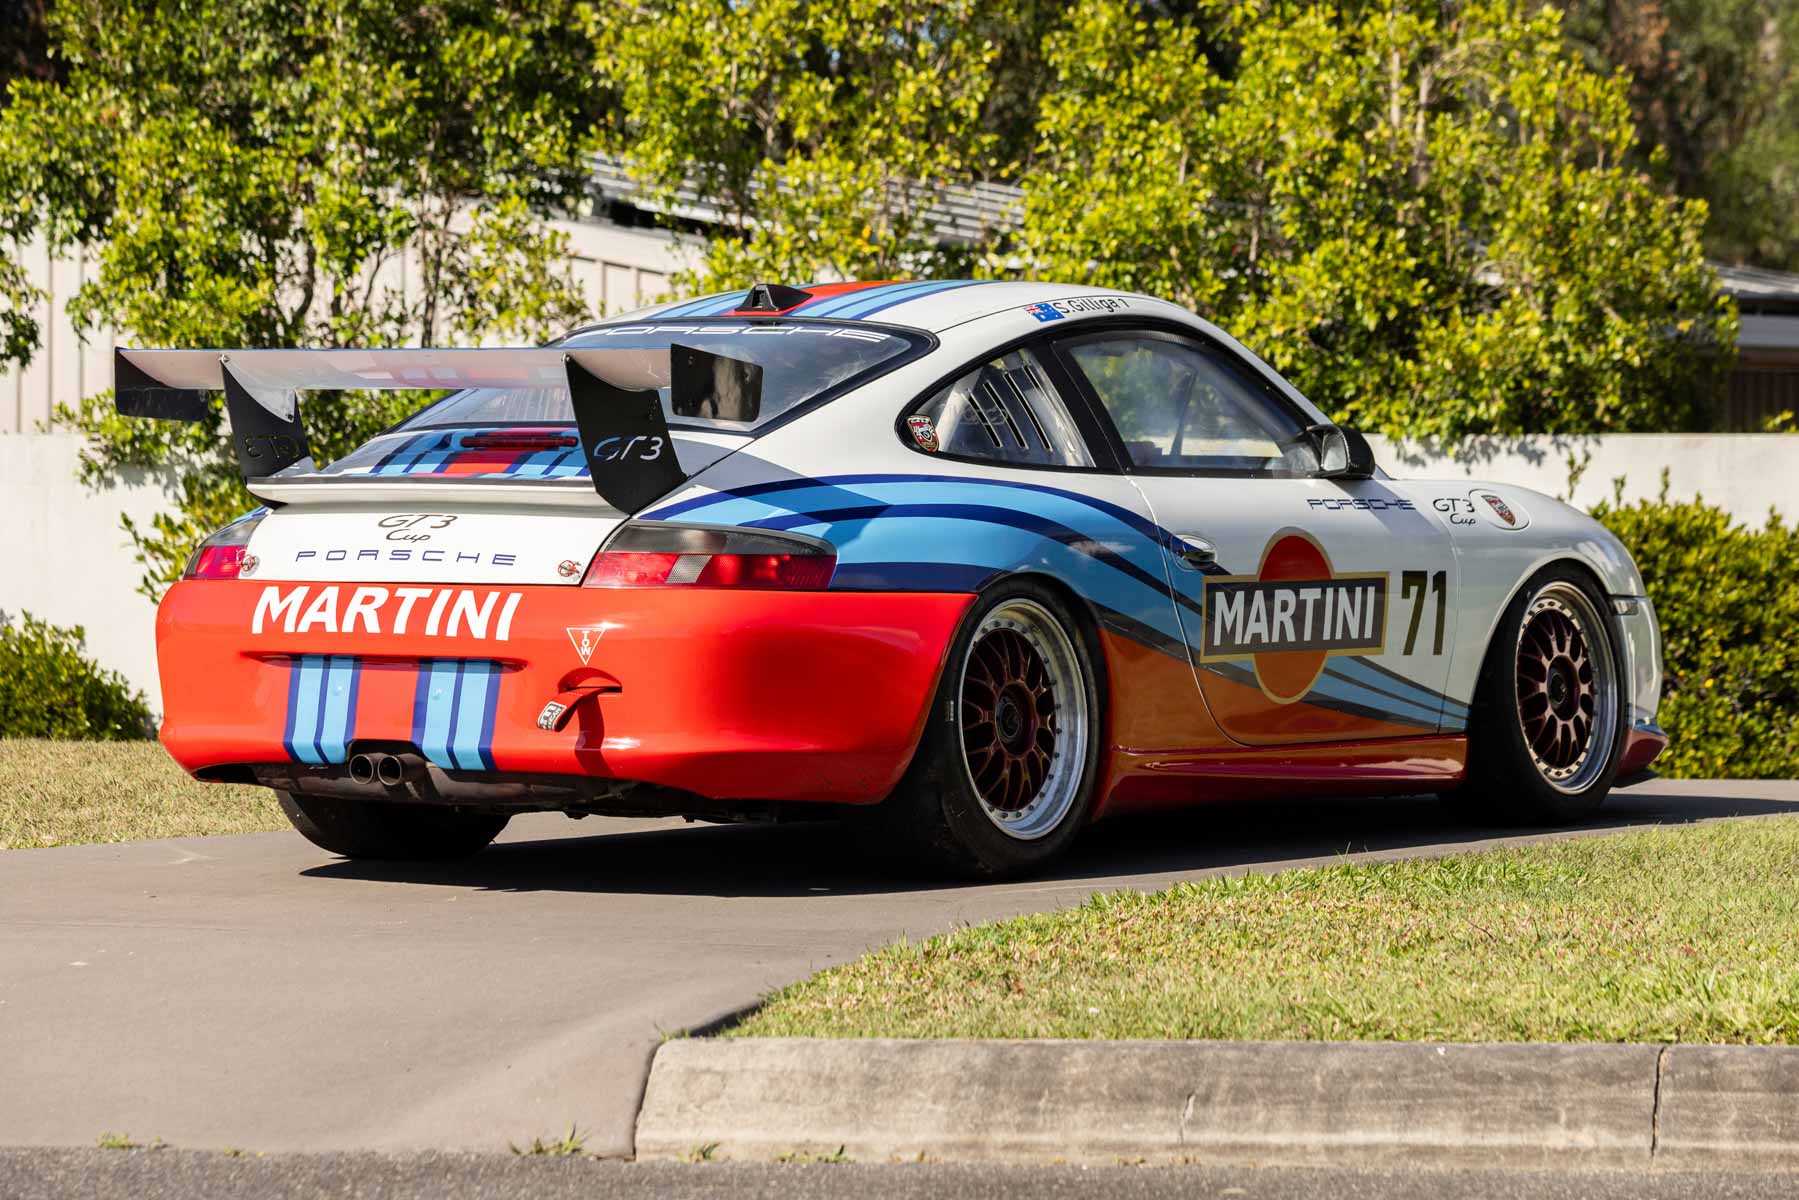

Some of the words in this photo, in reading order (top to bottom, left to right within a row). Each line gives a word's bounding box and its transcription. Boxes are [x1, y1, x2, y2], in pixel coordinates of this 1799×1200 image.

[565, 326, 890, 343] ORSCHE
[593, 435, 664, 461] GT3
[1306, 498, 1417, 511] PORSCHE
[1432, 498, 1476, 513] GT3
[377, 514, 459, 529] GT3
[1449, 512, 1477, 526] Cup
[385, 528, 432, 544] Cup
[295, 549, 517, 567] PORSCHE
[251, 585, 524, 641] MARTINI
[1213, 586, 1376, 647] MARTINI
[1401, 570, 1447, 656] 71
[580, 630, 592, 656] TOW
